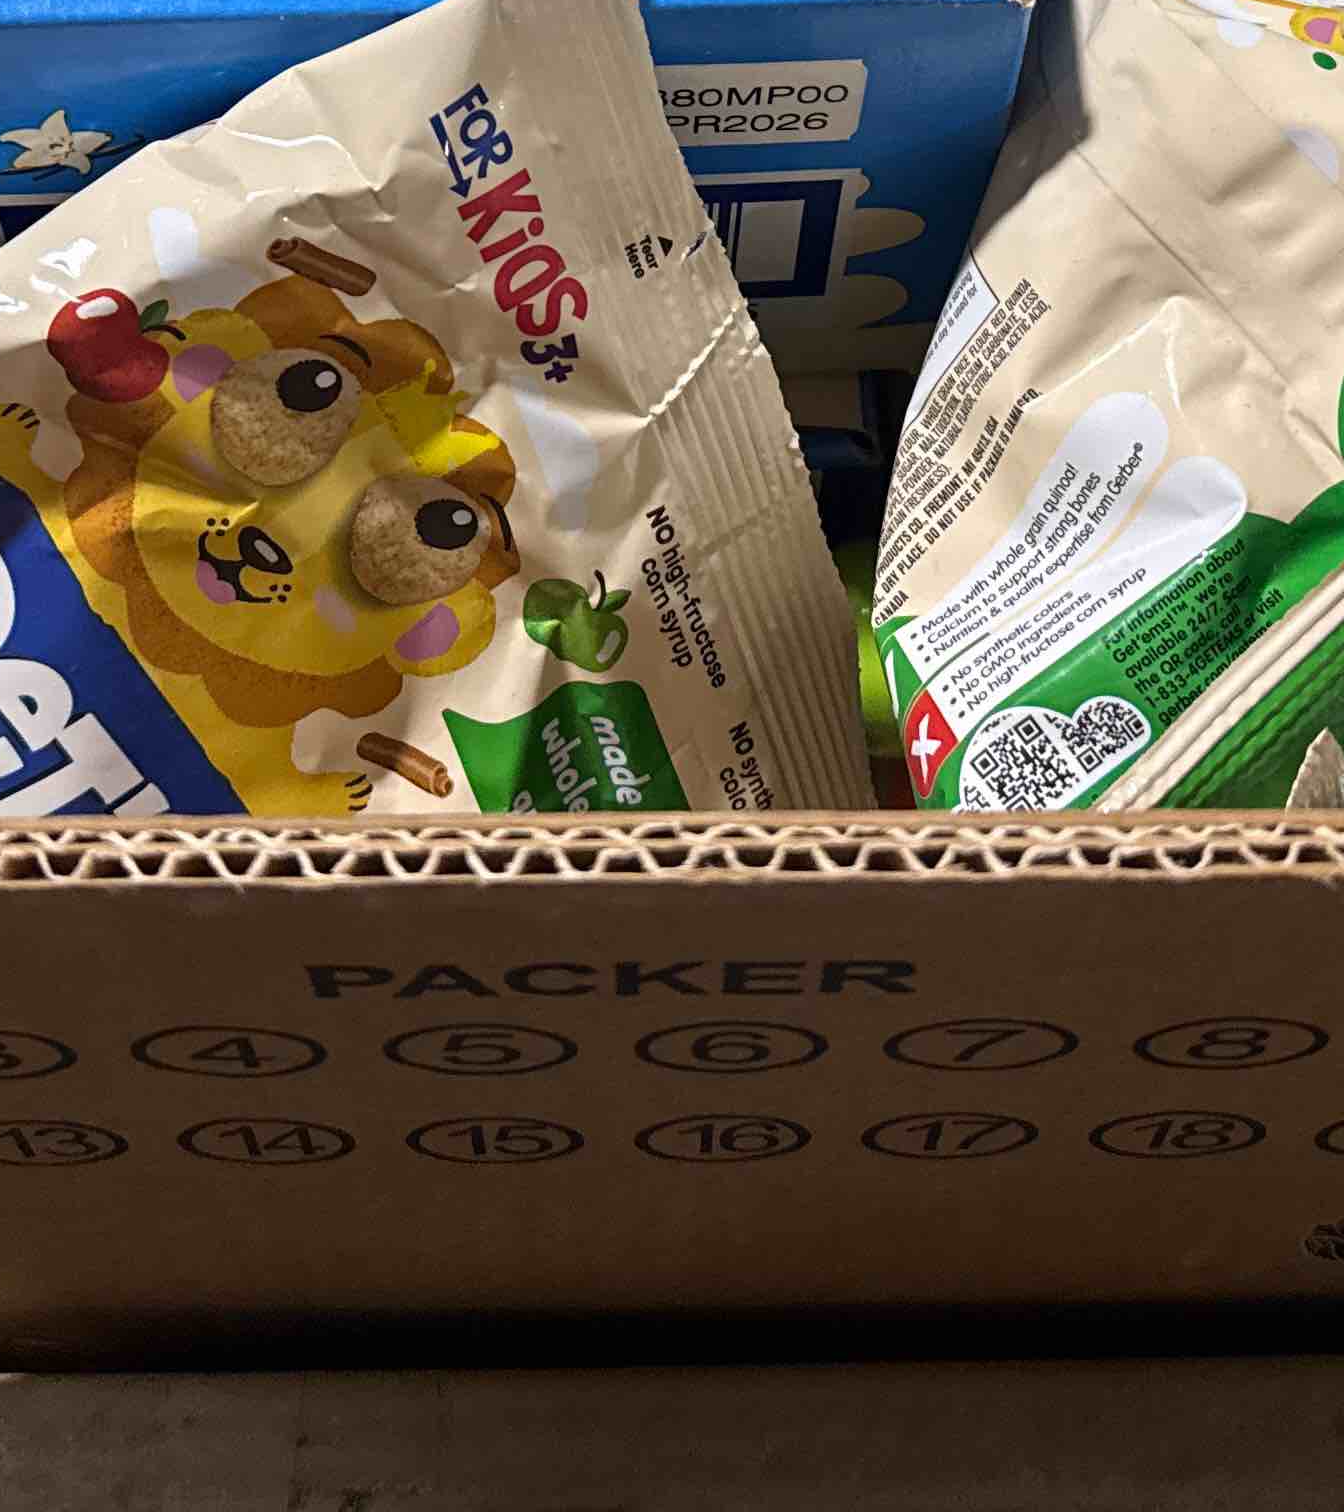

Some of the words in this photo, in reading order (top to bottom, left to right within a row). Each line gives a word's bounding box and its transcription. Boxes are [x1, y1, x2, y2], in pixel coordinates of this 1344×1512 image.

[444, 82, 513, 179] FOR
[625, 243, 644, 279] Here
[639, 234, 658, 269] Tear
[521, 333, 578, 383] 3+
[920, 601, 961, 635] Made
[962, 580, 990, 605] with
[988, 543, 1026, 583] whole
[1025, 513, 1049, 546] grain
[1044, 461, 1080, 515] quinoa!
[927, 604, 981, 645] Calcium
[982, 593, 997, 607] to
[998, 548, 1046, 597] support
[1044, 510, 1071, 554] strong
[1070, 473, 1101, 515] bones
[934, 615, 990, 656] Nutrition
[990, 605, 1002, 617] &
[1003, 574, 1044, 612] quality
[1045, 528, 1093, 580] expertise
[1089, 493, 1114, 531] from
[642, 558, 670, 616] corn
[660, 612, 693, 668] syrup
[646, 505, 674, 544] NO
[662, 543, 726, 688] high-fructose
[543, 719, 597, 813] whole
[591, 716, 651, 805] made
[301, 958, 920, 999] PACKER
[217, 1122, 321, 1158] 14
[445, 1121, 556, 1157] 15
[676, 1119, 779, 1155] 16
[906, 1118, 1008, 1154] 17
[1137, 1116, 1239, 1152] 18
